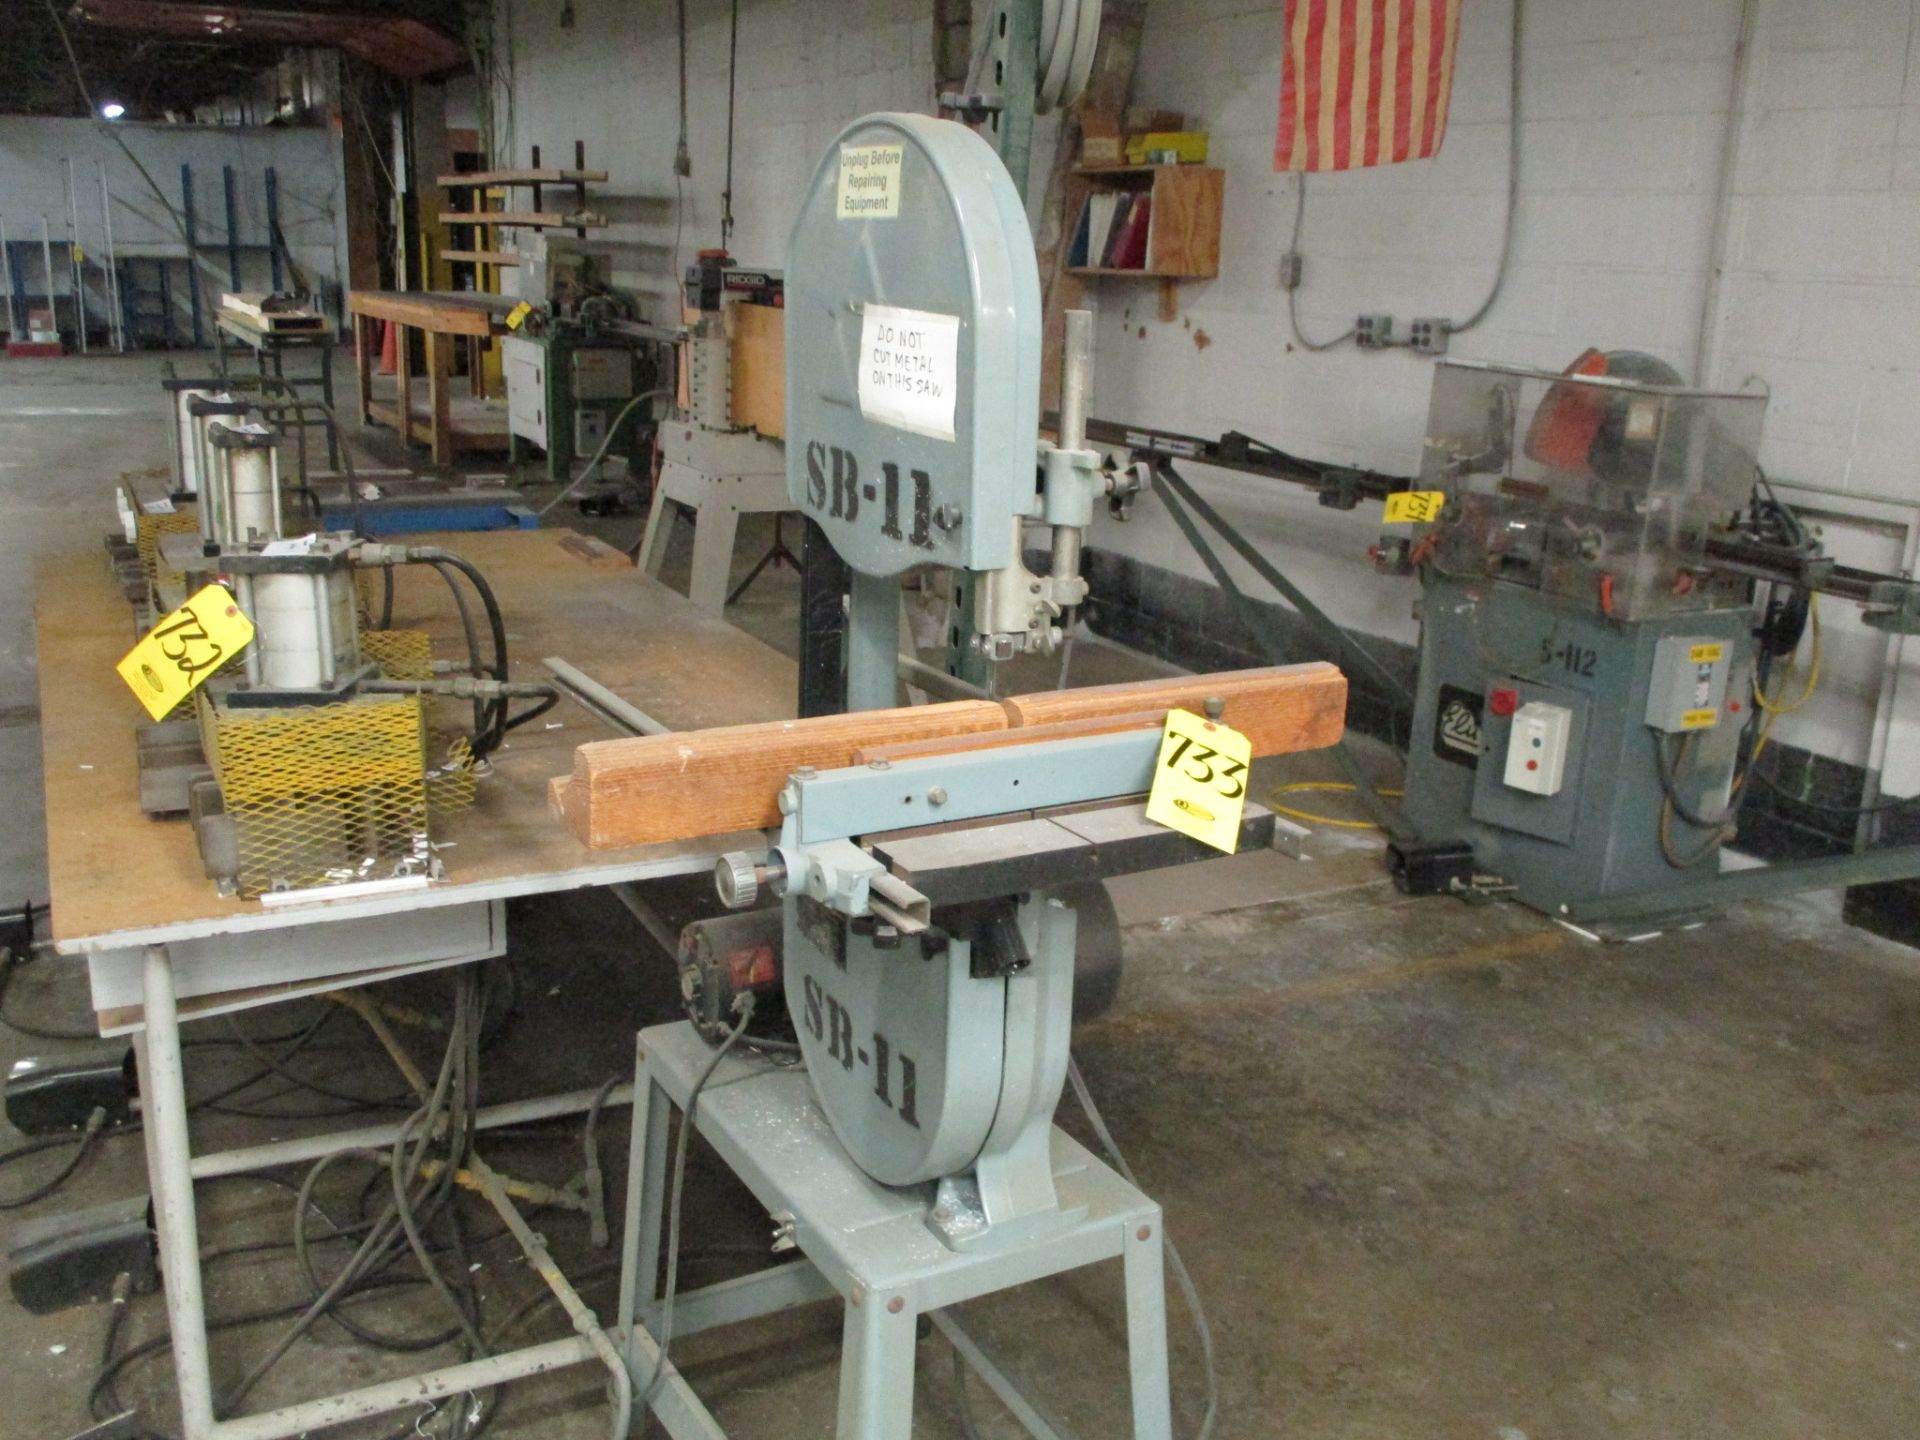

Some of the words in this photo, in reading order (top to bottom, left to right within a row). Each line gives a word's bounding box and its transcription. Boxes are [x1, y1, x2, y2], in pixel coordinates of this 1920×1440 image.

[842, 151, 869, 170] Unplug
[870, 149, 900, 166] Before
[848, 173, 887, 192] Repairing
[844, 195, 888, 213] Equipment
[726, 274, 766, 285] RIDGID
[877, 323, 894, 344] DO
[900, 329, 926, 350] NOT
[873, 348, 891, 367] CUT
[895, 353, 934, 373] METAL
[916, 379, 943, 398] SAW
[806, 440, 935, 551] SB-11
[154, 606, 222, 688] 732
[1540, 638, 1598, 677] S-112
[1166, 730, 1248, 799] 733
[804, 974, 921, 1131] SB-11
